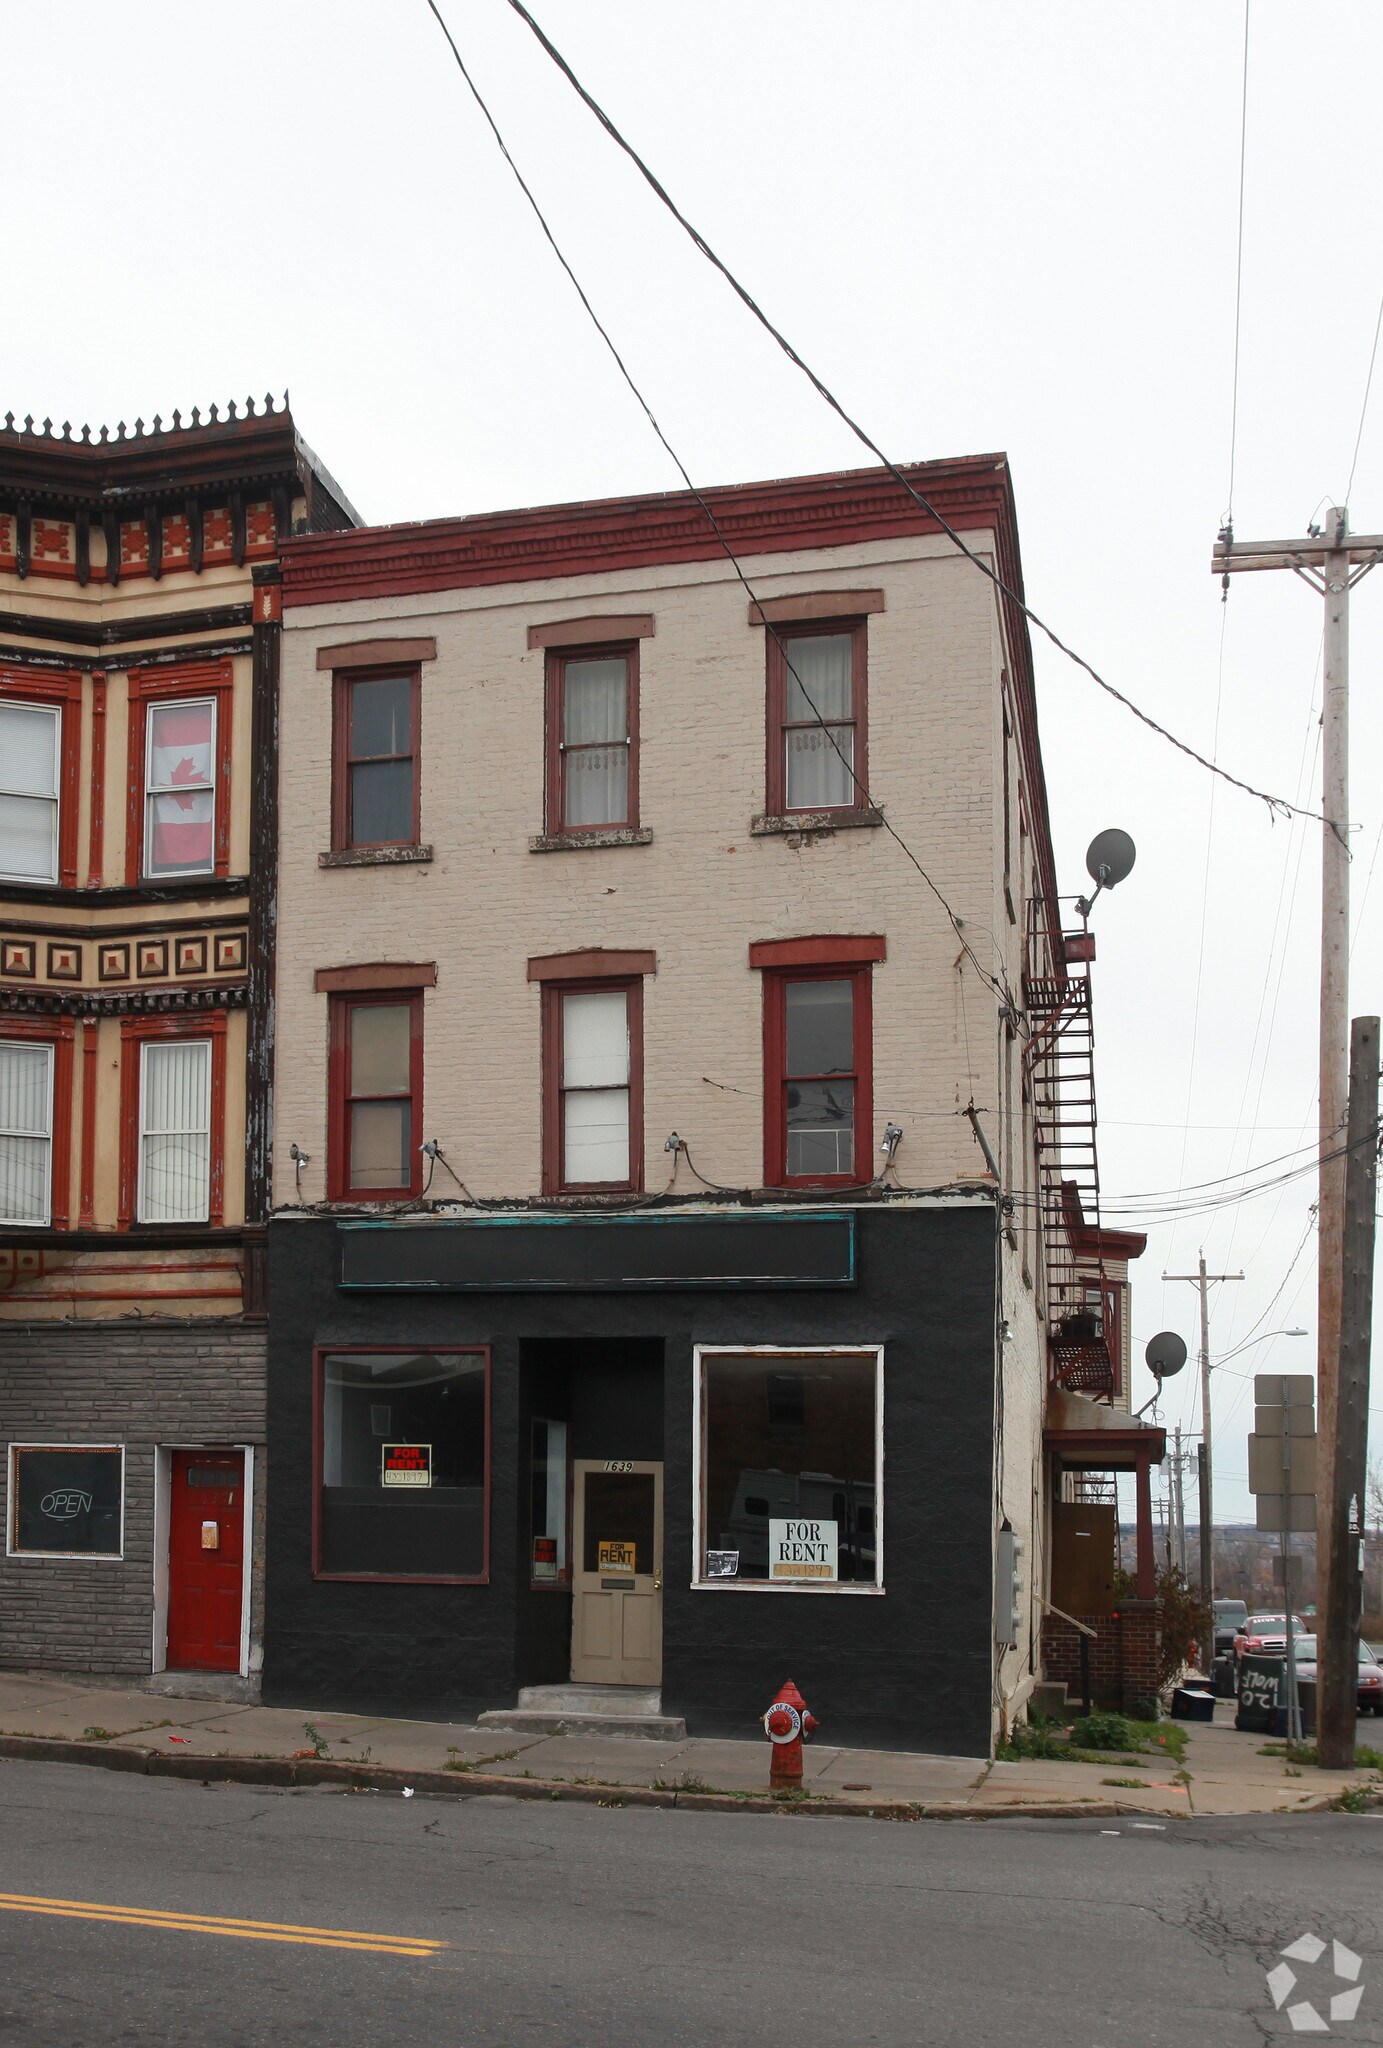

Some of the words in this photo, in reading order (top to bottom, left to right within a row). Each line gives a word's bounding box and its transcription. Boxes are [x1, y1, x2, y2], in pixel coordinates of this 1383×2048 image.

[394, 1448, 420, 1458] FOR
[387, 1459, 427, 1469] RENT
[605, 1461, 633, 1471] 1639
[41, 1494, 93, 1513] OPEN
[785, 1522, 821, 1541] FOR
[600, 1550, 634, 1563] RENT
[779, 1542, 829, 1562] RENT
[1242, 1670, 1279, 1692] WOLF
[766, 1707, 775, 1720] OUT
[784, 1705, 800, 1730] SERVICE
